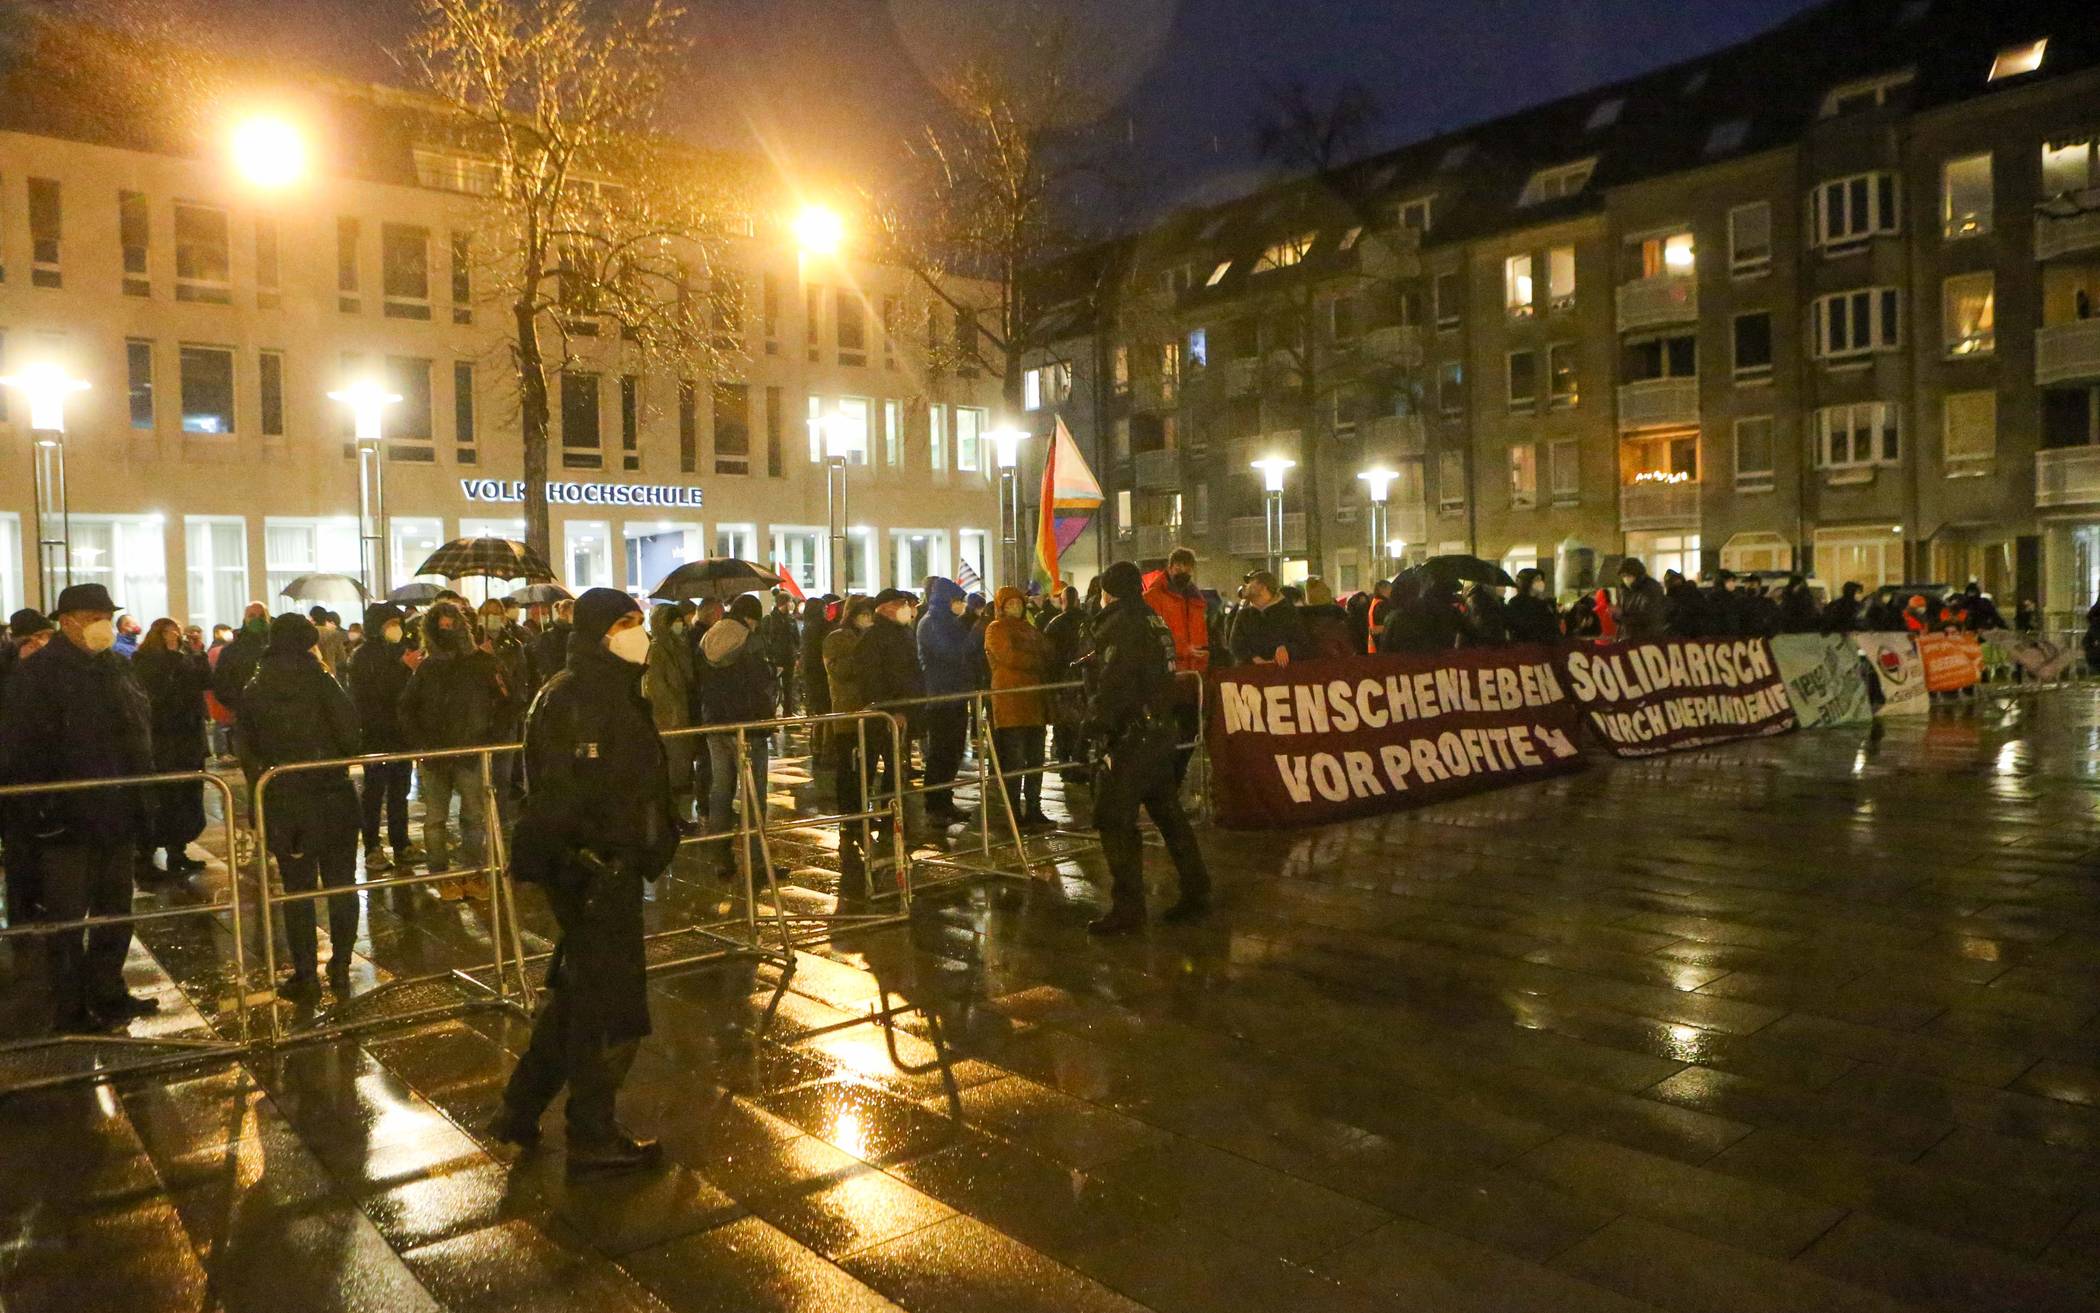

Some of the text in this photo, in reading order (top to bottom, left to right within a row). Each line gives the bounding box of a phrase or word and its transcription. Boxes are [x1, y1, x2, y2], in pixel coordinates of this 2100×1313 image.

[461, 480, 703, 507] VOLKHOCHSCHULE
[1220, 661, 1565, 735] MENSCHENLEBEN
[1568, 638, 1772, 702] SOLIDARISCH
[1274, 725, 1544, 804] VOR PROFITE
